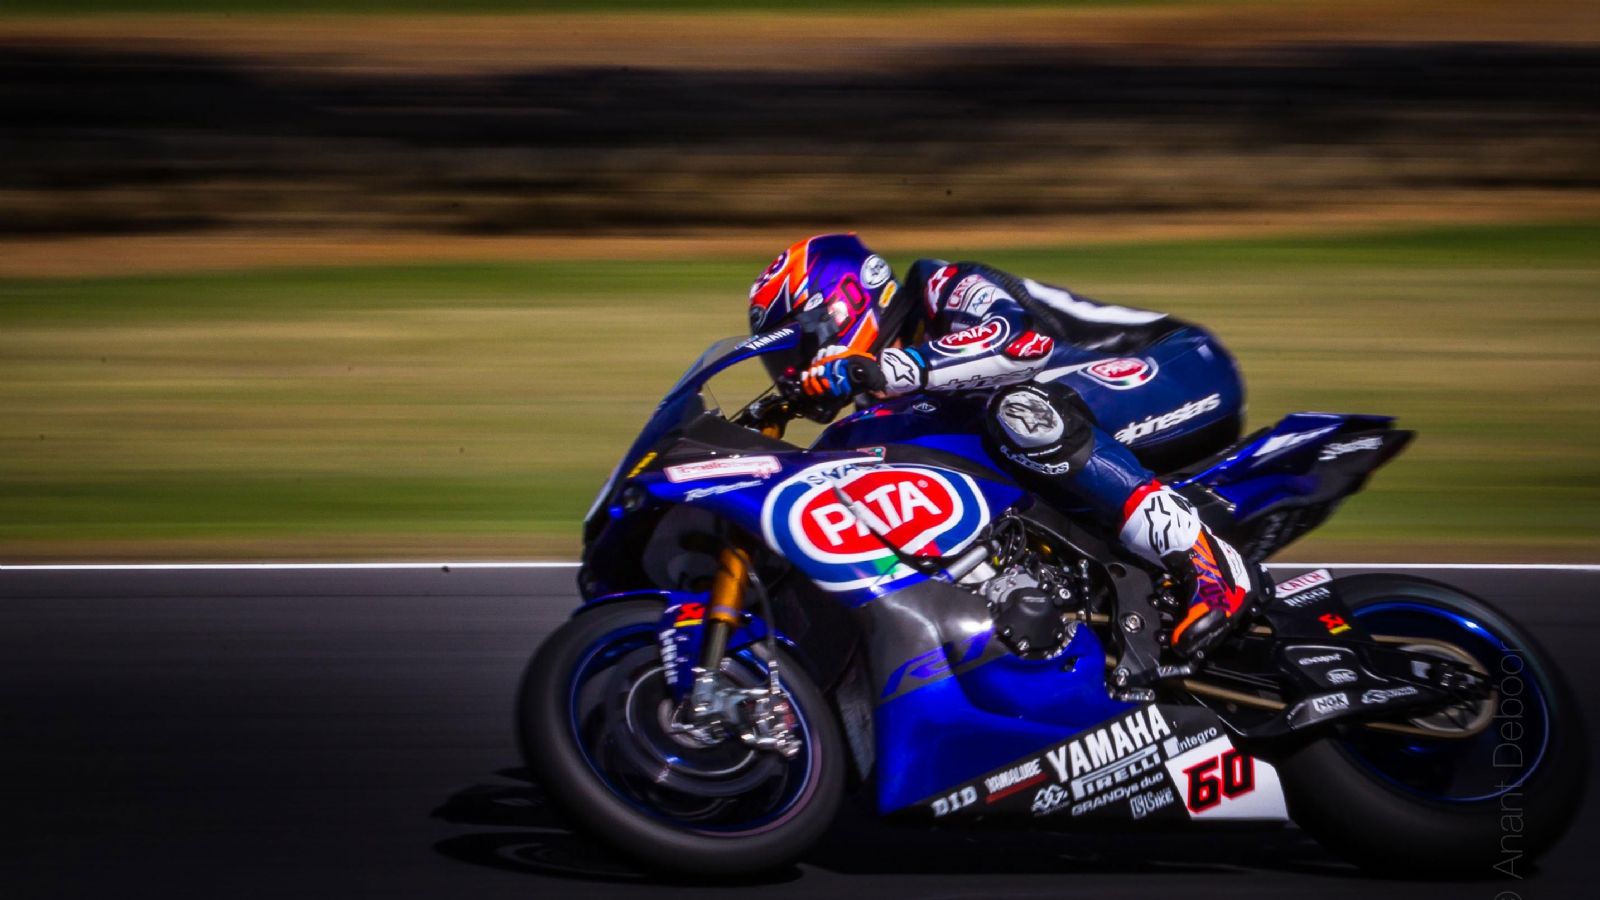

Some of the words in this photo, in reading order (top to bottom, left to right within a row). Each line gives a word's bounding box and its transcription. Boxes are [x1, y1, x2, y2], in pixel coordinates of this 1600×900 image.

[745, 328, 795, 350] YAMAHA
[946, 325, 993, 346] PATA
[811, 480, 942, 547] PATA
[1046, 704, 1171, 783] YAMAHA
[1071, 744, 1161, 801] PIRELLI
[1182, 748, 1255, 814] 60
